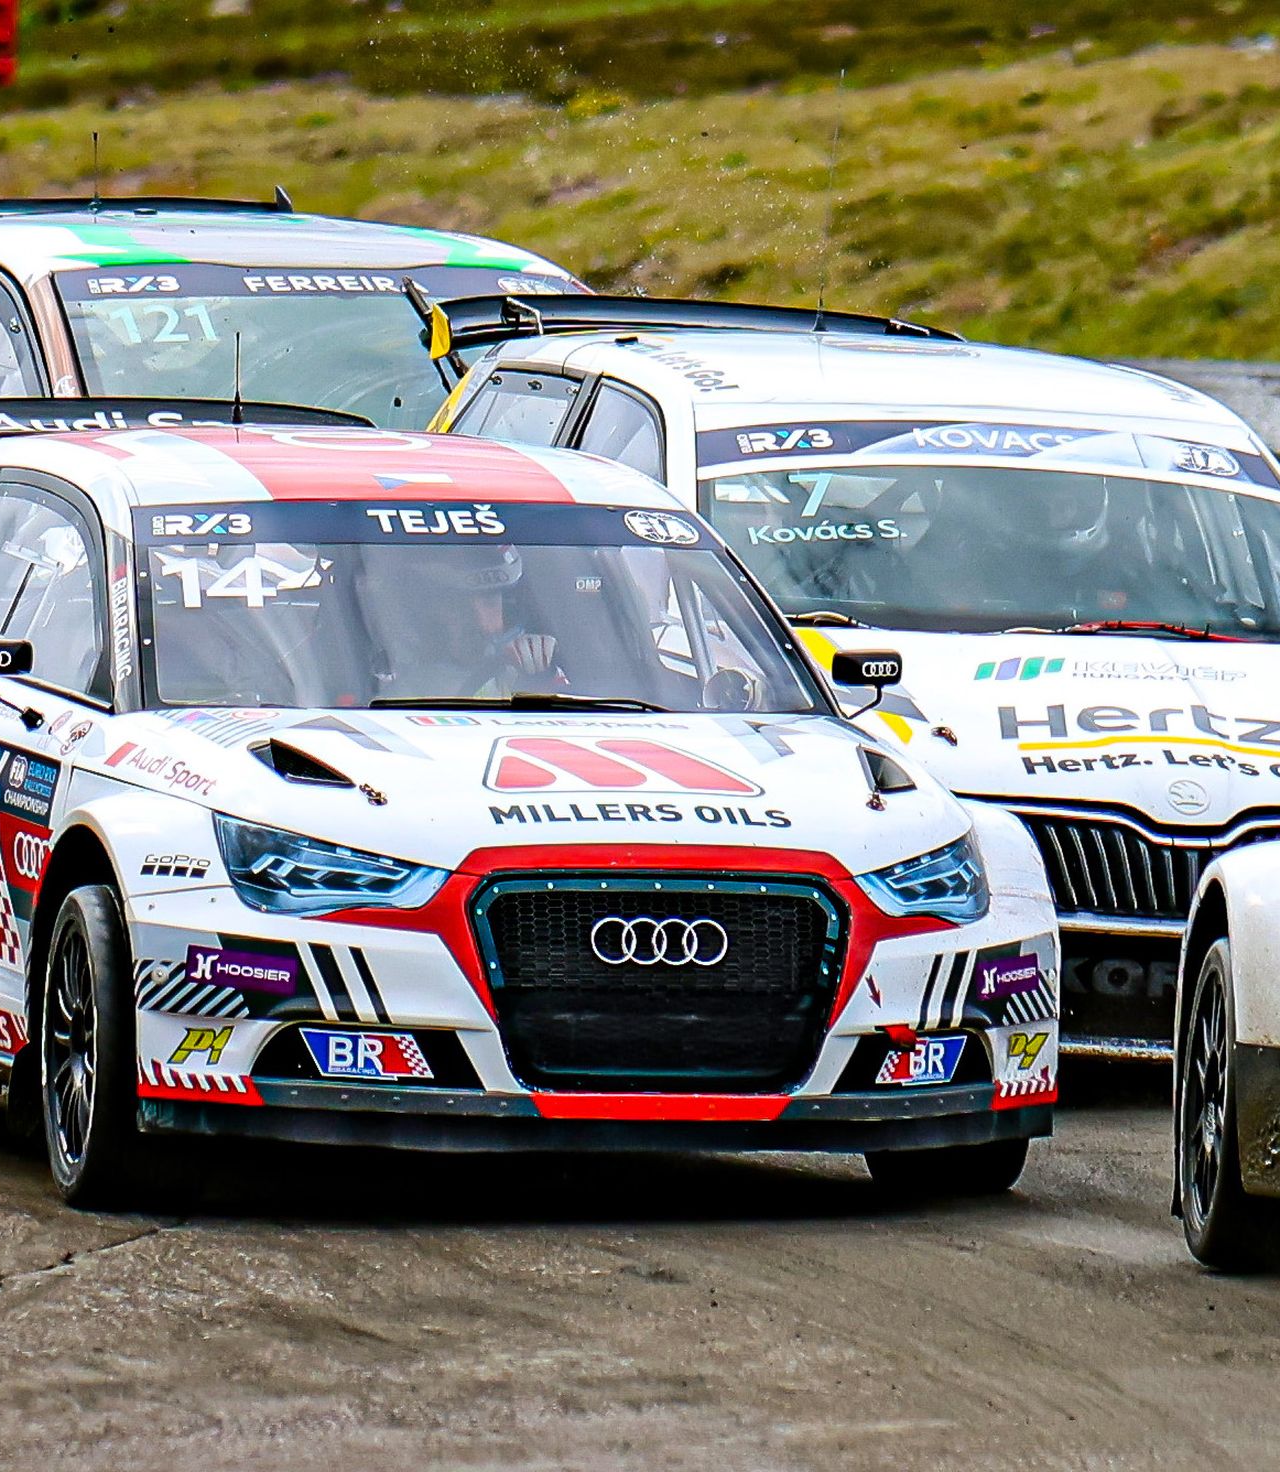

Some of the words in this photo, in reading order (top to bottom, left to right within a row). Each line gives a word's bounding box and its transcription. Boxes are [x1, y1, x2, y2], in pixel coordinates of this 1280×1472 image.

[99, 276, 180, 294] RX3
[109, 301, 220, 344] 121
[748, 428, 834, 453] RX3
[789, 472, 837, 518] 7
[164, 514, 252, 535] RX3
[366, 503, 505, 535] TEJEŠ
[628, 514, 697, 541] FIA
[747, 518, 872, 545] Kovács
[879, 518, 909, 539] S.
[160, 552, 278, 608] 14
[127, 746, 169, 777] Audi
[168, 761, 218, 797] Sport
[1161, 748, 1261, 777] Let's
[487, 804, 684, 826] MILLERS
[694, 805, 793, 829] OILS
[143, 854, 211, 868] GoPro
[216, 963, 291, 983] HOOSIER
[328, 1036, 384, 1073] BR
